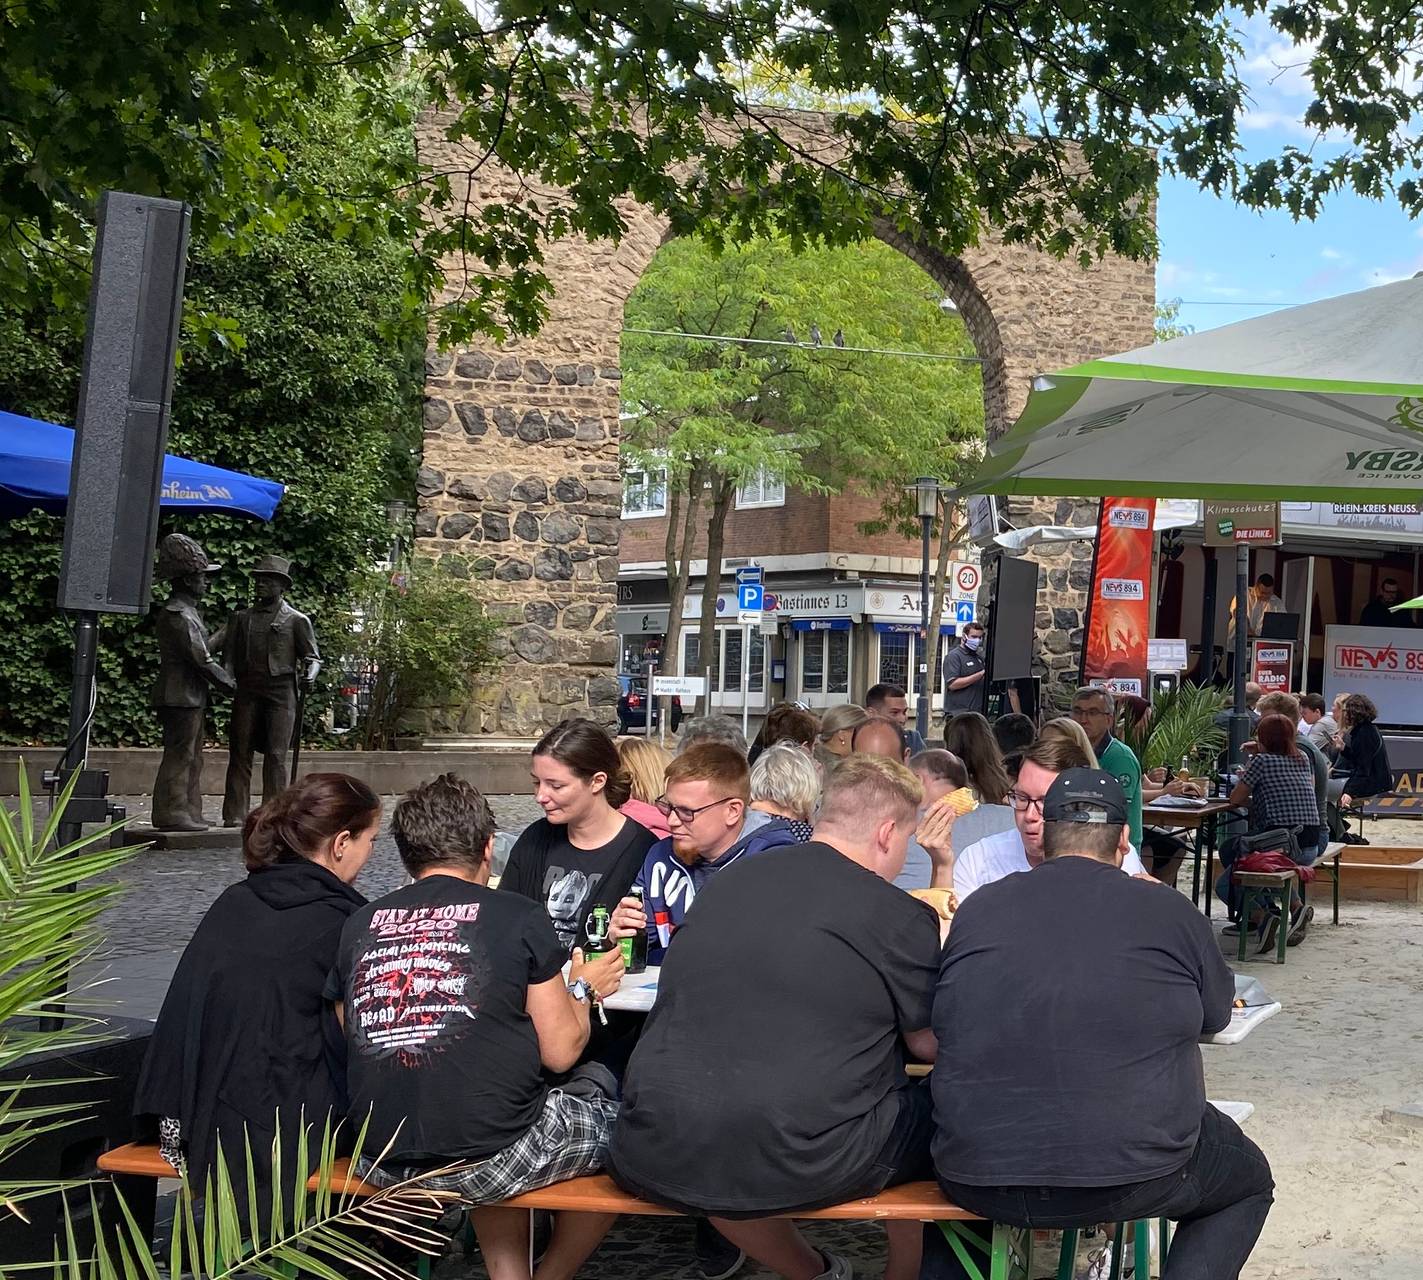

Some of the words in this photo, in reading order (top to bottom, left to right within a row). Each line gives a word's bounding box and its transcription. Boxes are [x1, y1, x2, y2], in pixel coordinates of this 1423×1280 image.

[1333, 503, 1386, 513] RHEIN-KREIS
[1114, 511, 1132, 521] NEWS
[1236, 530, 1248, 538] DIE
[962, 573, 974, 584] 20
[1105, 583, 1123, 592] NEWS
[744, 589, 757, 607] P
[835, 594, 848, 608] 13
[958, 592, 975, 600] ZONE
[1341, 642, 1398, 669] NEWS
[1258, 675, 1287, 683] RADIO
[369, 908, 409, 929] STAY
[408, 908, 430, 922] AT
[430, 902, 480, 921] HOME
[378, 919, 458, 936] 2020
